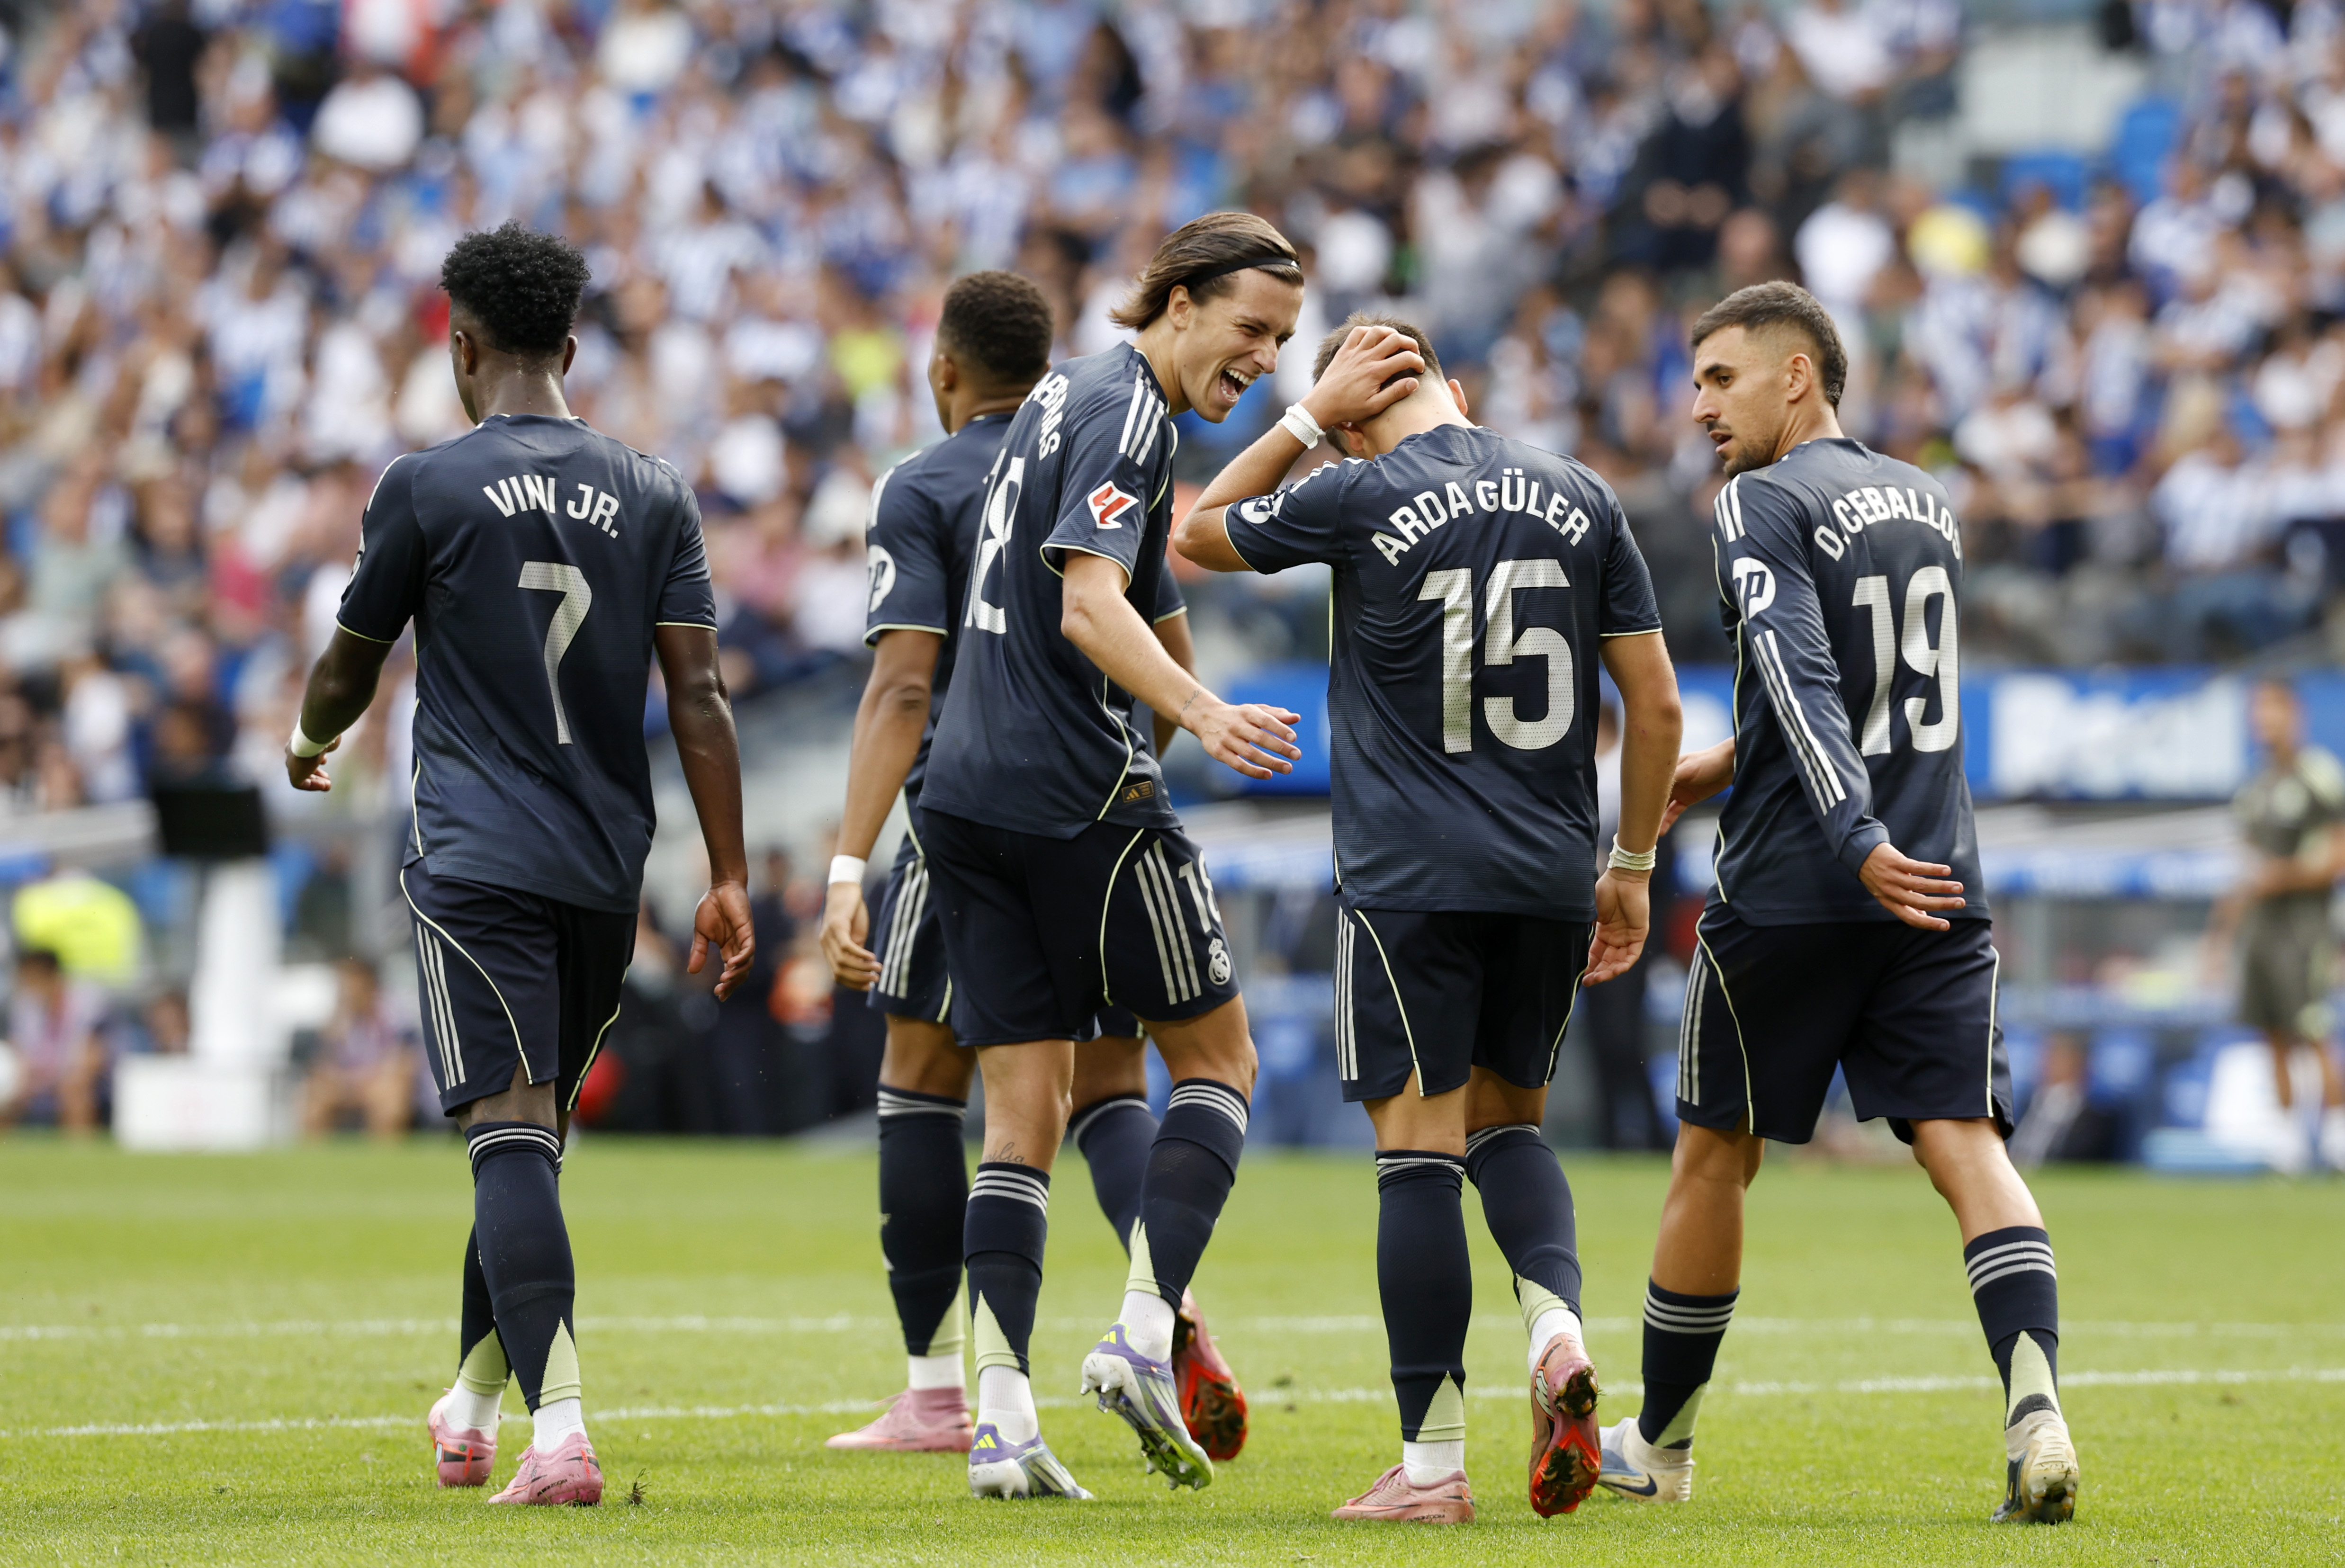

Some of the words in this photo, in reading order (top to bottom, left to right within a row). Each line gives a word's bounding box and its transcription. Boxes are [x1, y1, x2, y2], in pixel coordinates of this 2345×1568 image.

[483, 475, 556, 518] VINI
[567, 483, 619, 538] JR.
[1371, 481, 1474, 567] ARDA
[1476, 468, 1590, 547] GÜLER
[517, 560, 593, 744] 7
[1417, 559, 1575, 754] 15
[1851, 566, 1959, 757] 19
